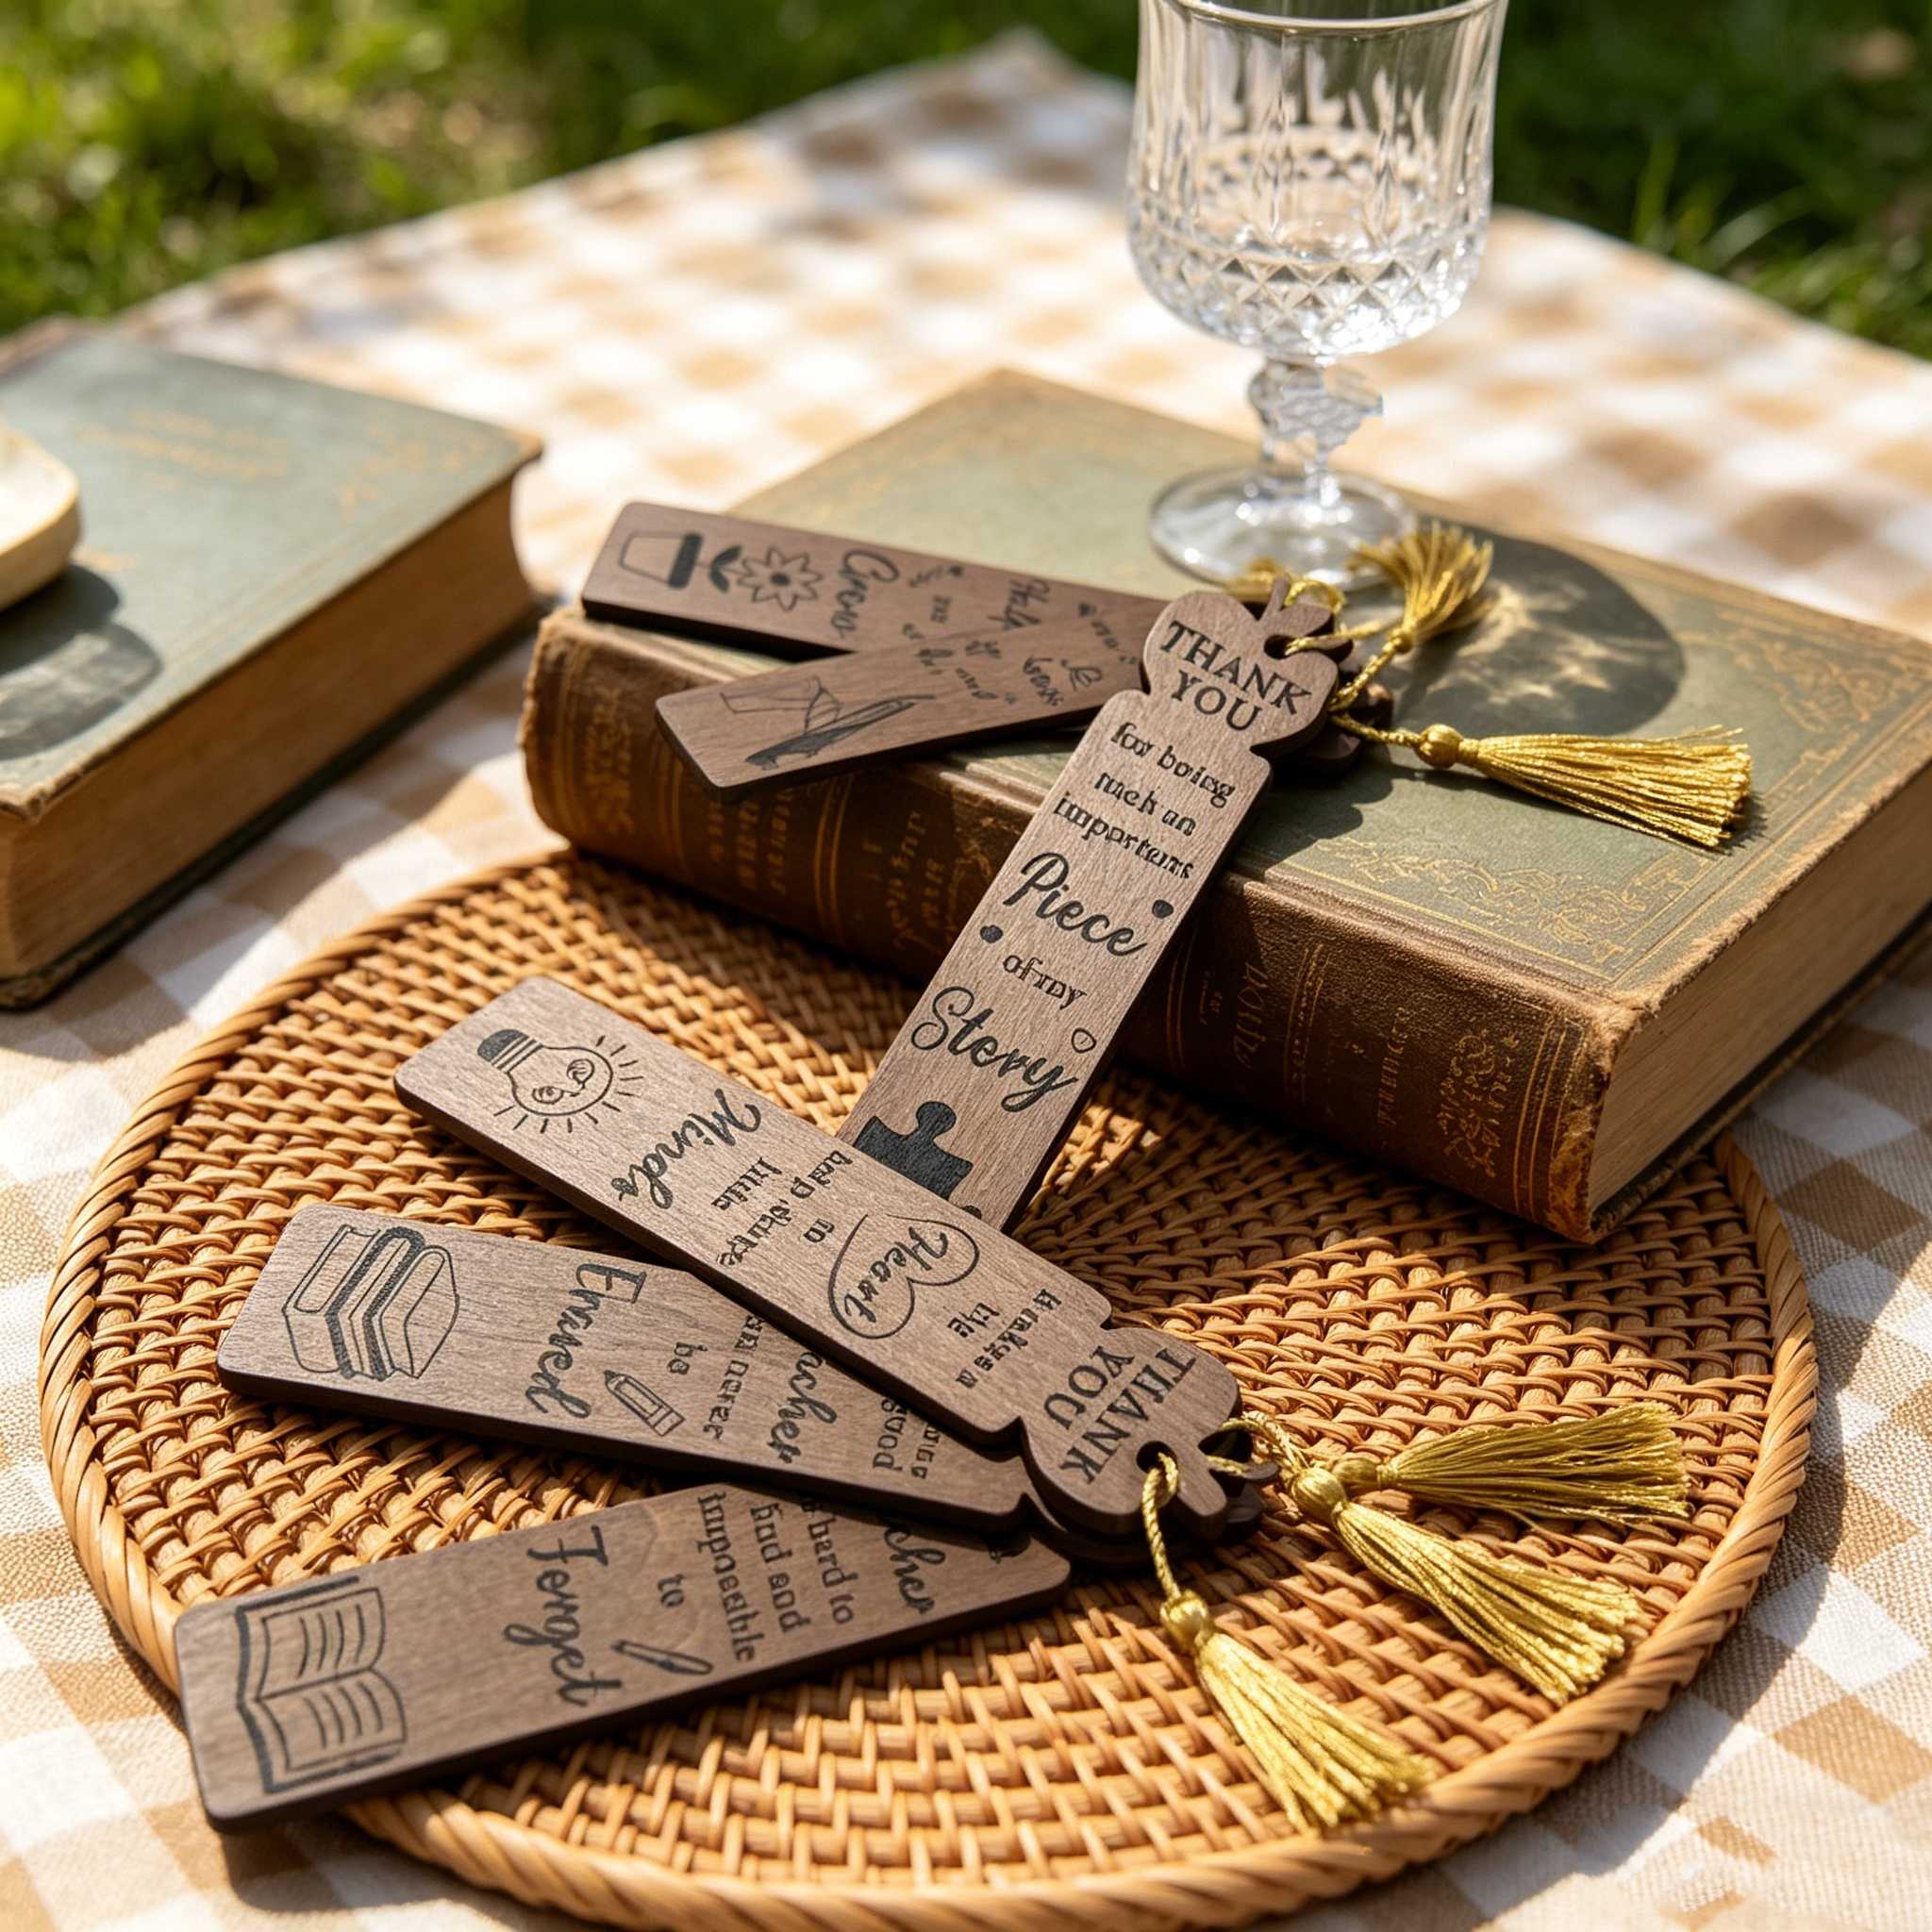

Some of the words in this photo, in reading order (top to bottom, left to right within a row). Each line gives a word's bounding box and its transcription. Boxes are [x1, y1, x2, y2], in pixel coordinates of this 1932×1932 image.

[1159, 620, 1312, 715] THANK
[1171, 670, 1262, 731] YOU
[1002, 852, 1148, 957] Piece
[610, 1087, 762, 1210] Minds
[843, 1225, 950, 1324] Heart
[770, 1351, 838, 1463] acher
[1042, 1345, 1135, 1430] YOU
[1059, 1346, 1197, 1485] THANK
[657, 1573, 685, 1608] to
[808, 1514, 859, 1589] hard
[503, 1524, 624, 1707] Forget
[768, 1572, 811, 1633] and
[828, 1592, 857, 1625] to
